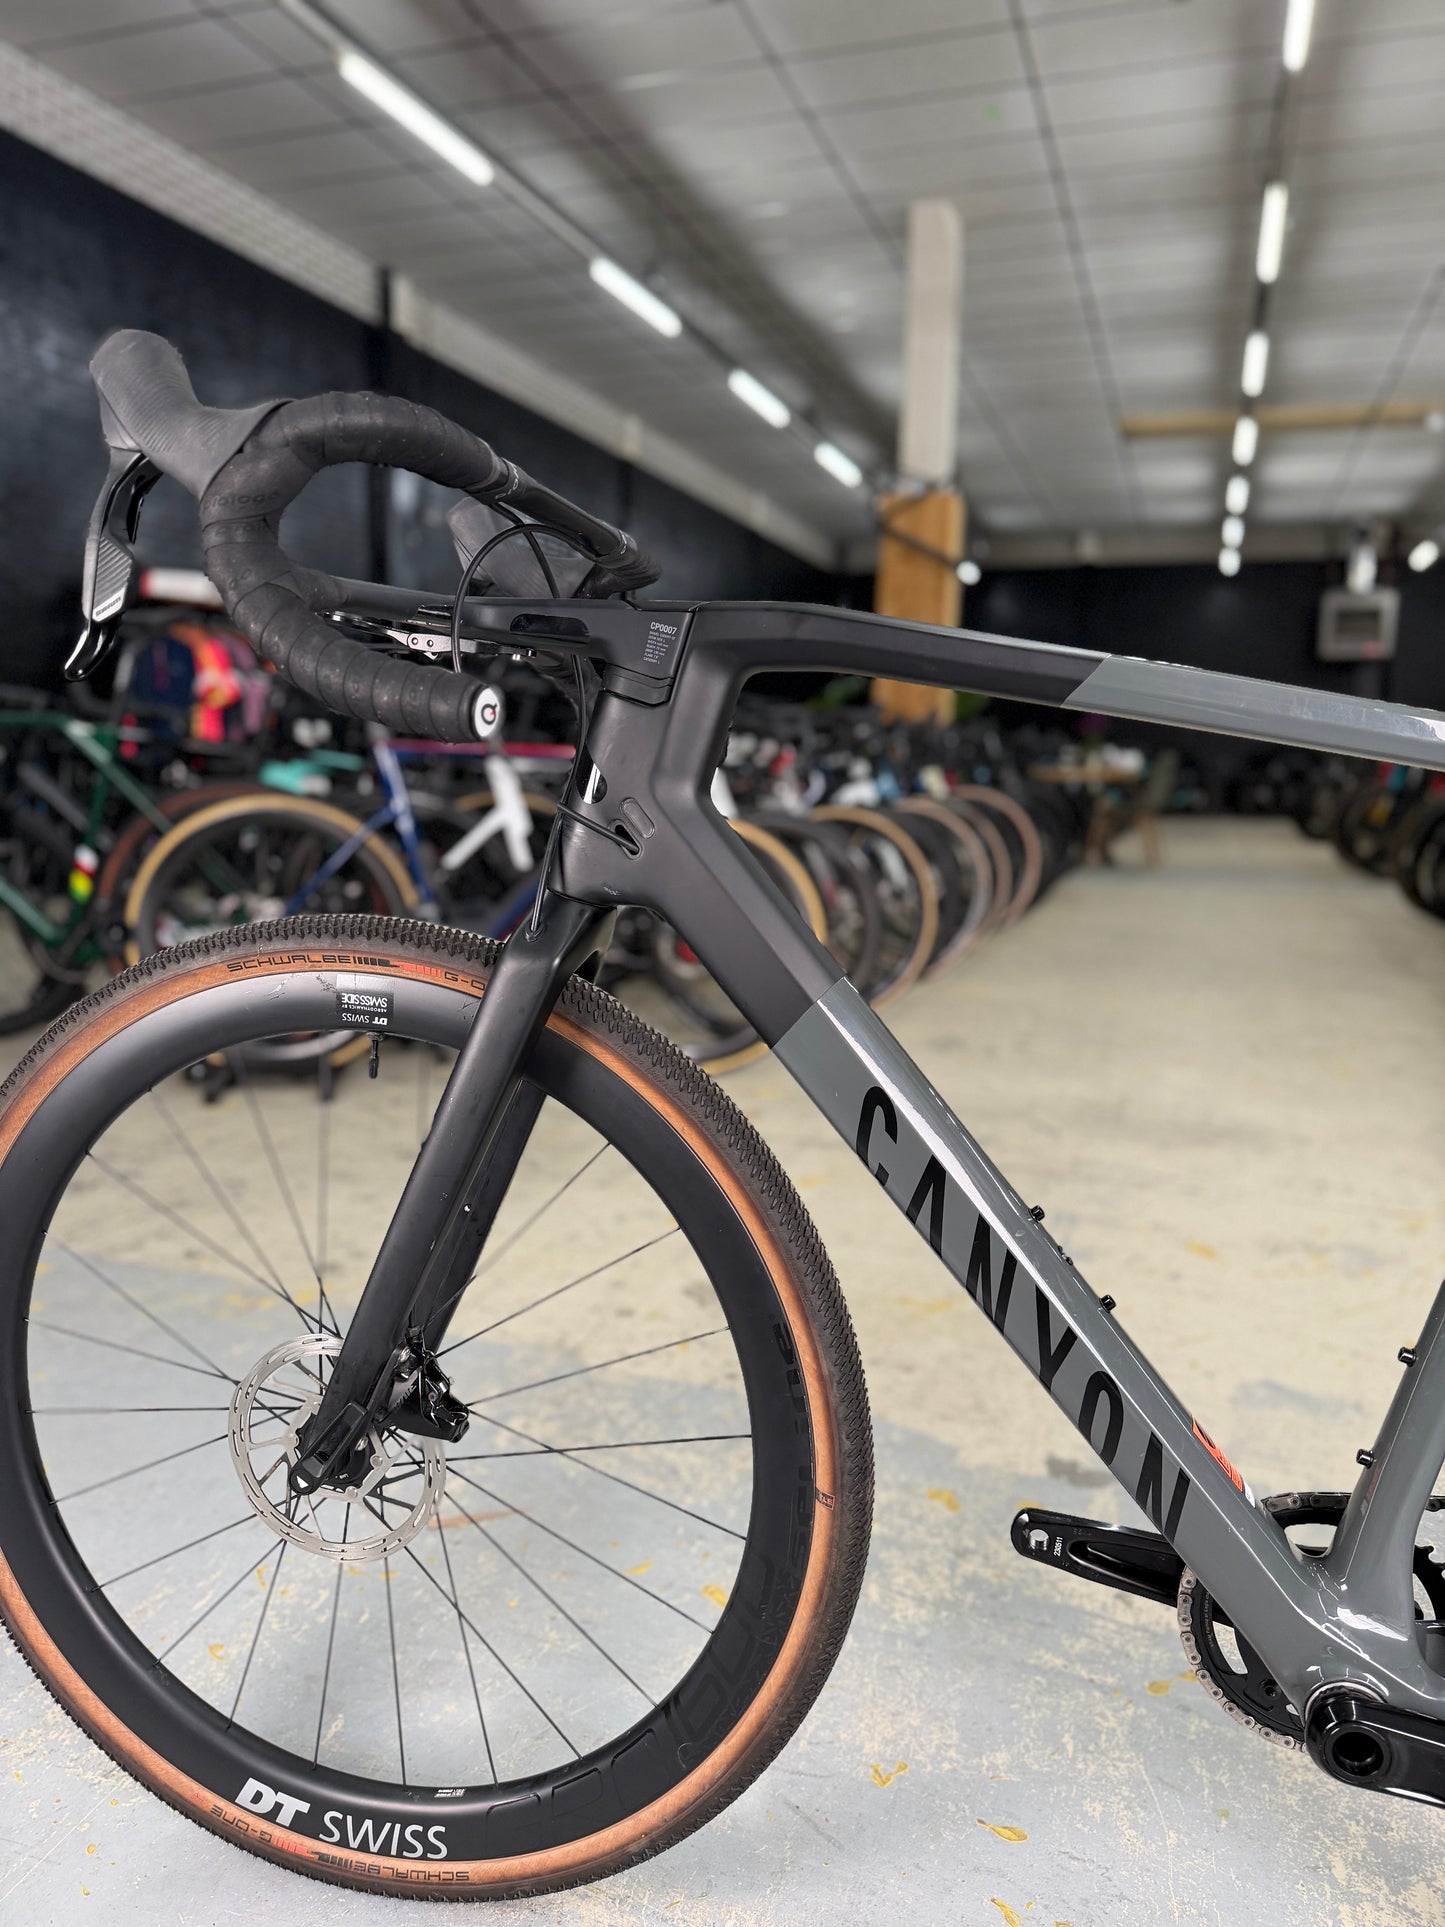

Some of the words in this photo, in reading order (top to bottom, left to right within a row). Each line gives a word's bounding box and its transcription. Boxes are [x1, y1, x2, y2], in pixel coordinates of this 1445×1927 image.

[650, 621, 677, 635] CP0007
[226, 954, 352, 972] SCHWALBE
[444, 971, 486, 991] G-O
[341, 1012, 370, 1024] SWISS
[372, 1017, 388, 1026] DT
[856, 1086, 1191, 1541] CANYON
[210, 1804, 273, 1843] G-ONE
[235, 1777, 311, 1827] DT
[318, 1810, 449, 1860] SWISS
[354, 1862, 470, 1882] SCHWALBE
